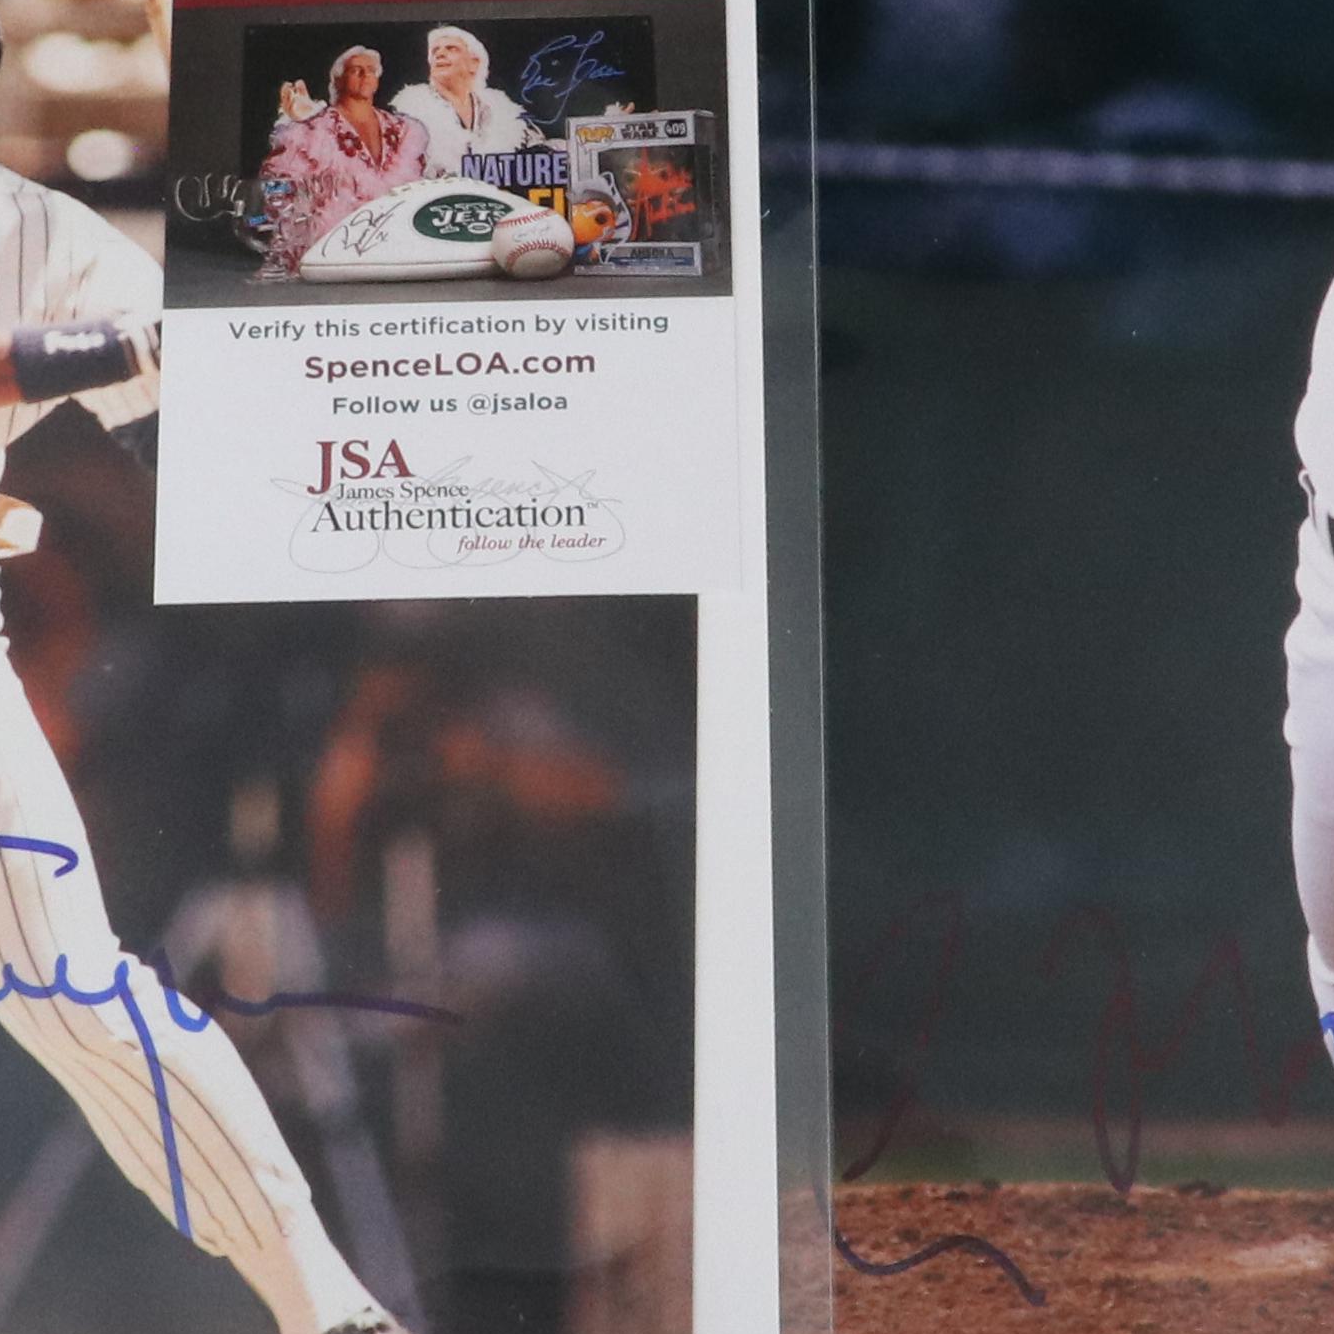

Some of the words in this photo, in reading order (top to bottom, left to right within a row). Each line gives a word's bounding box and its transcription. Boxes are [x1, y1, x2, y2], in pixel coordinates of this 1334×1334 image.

[462, 152, 568, 186] NATURE
[228, 319, 306, 342] Verify
[314, 318, 361, 338] this
[369, 315, 525, 337] certification
[535, 314, 567, 336] by
[575, 312, 669, 334] visiting
[305, 351, 595, 384] SpenceLOA.com
[333, 395, 421, 415] Follow
[429, 398, 458, 413] us
[466, 392, 568, 416] @jsaloa
[307, 439, 414, 494] JSA
[337, 482, 394, 501] James
[400, 481, 468, 503] Spence
[458, 535, 511, 554] follow
[518, 535, 545, 550] the
[551, 534, 606, 550] leader
